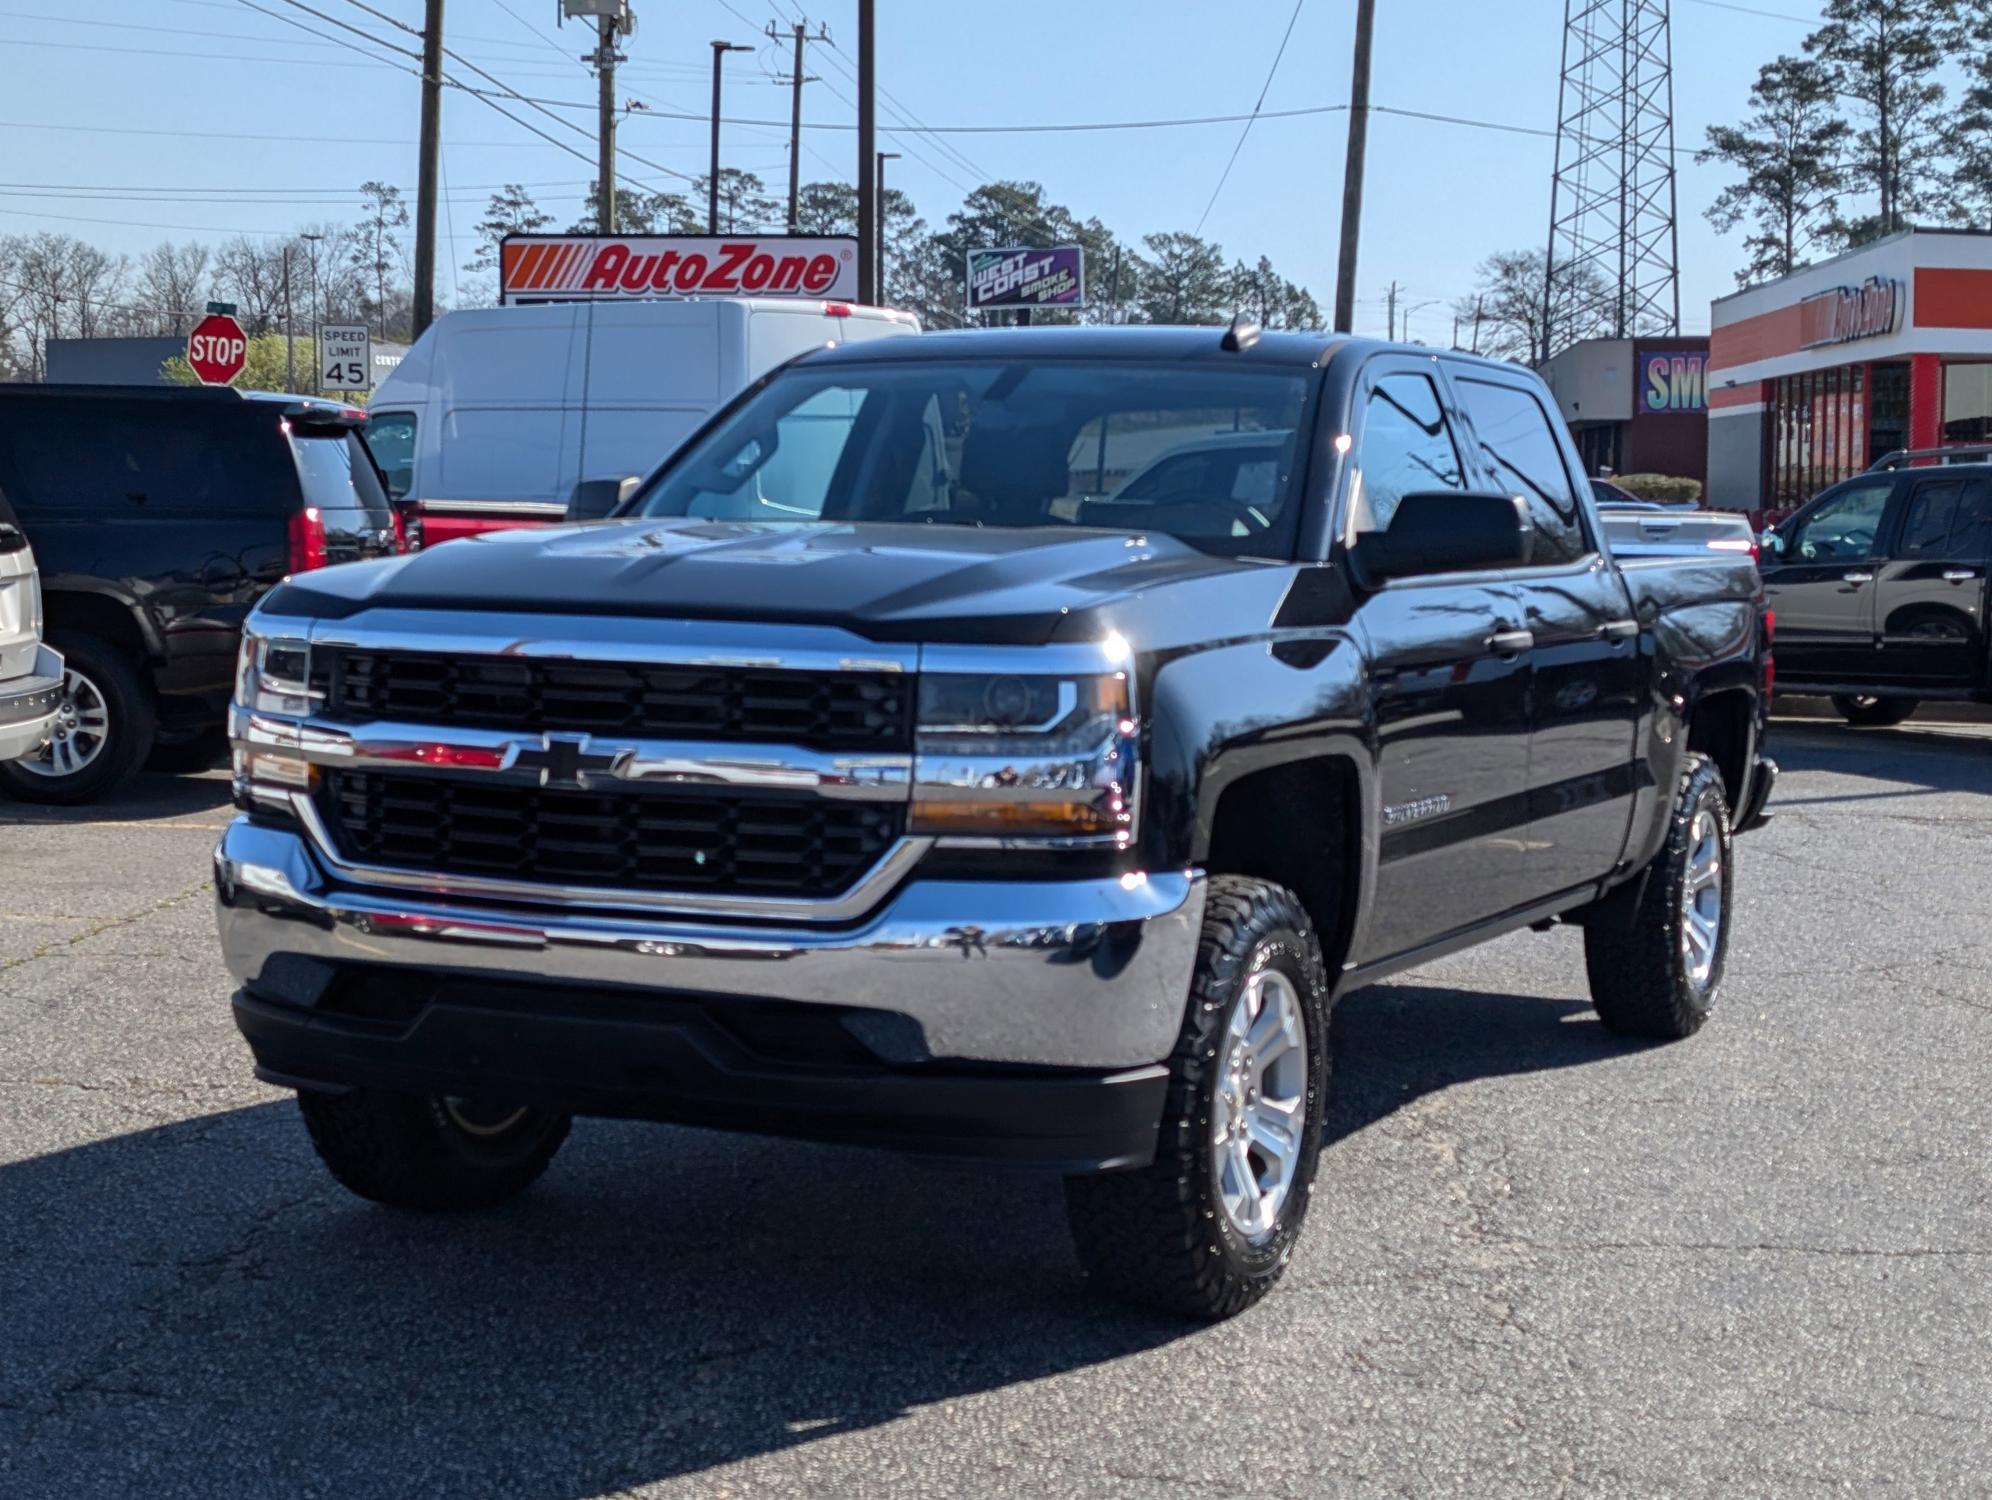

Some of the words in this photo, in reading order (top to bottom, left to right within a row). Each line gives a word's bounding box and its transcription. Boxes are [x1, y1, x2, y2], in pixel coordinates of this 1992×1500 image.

[581, 244, 838, 291] AutoZone
[973, 252, 1027, 288] WEST
[978, 255, 1055, 302] COAST
[1021, 268, 1069, 298] SMOKE
[1038, 277, 1076, 302] SHOP
[191, 334, 245, 366] STOP
[324, 330, 366, 342] SPEED
[328, 346, 361, 357] LIMIT
[326, 362, 364, 384] 45
